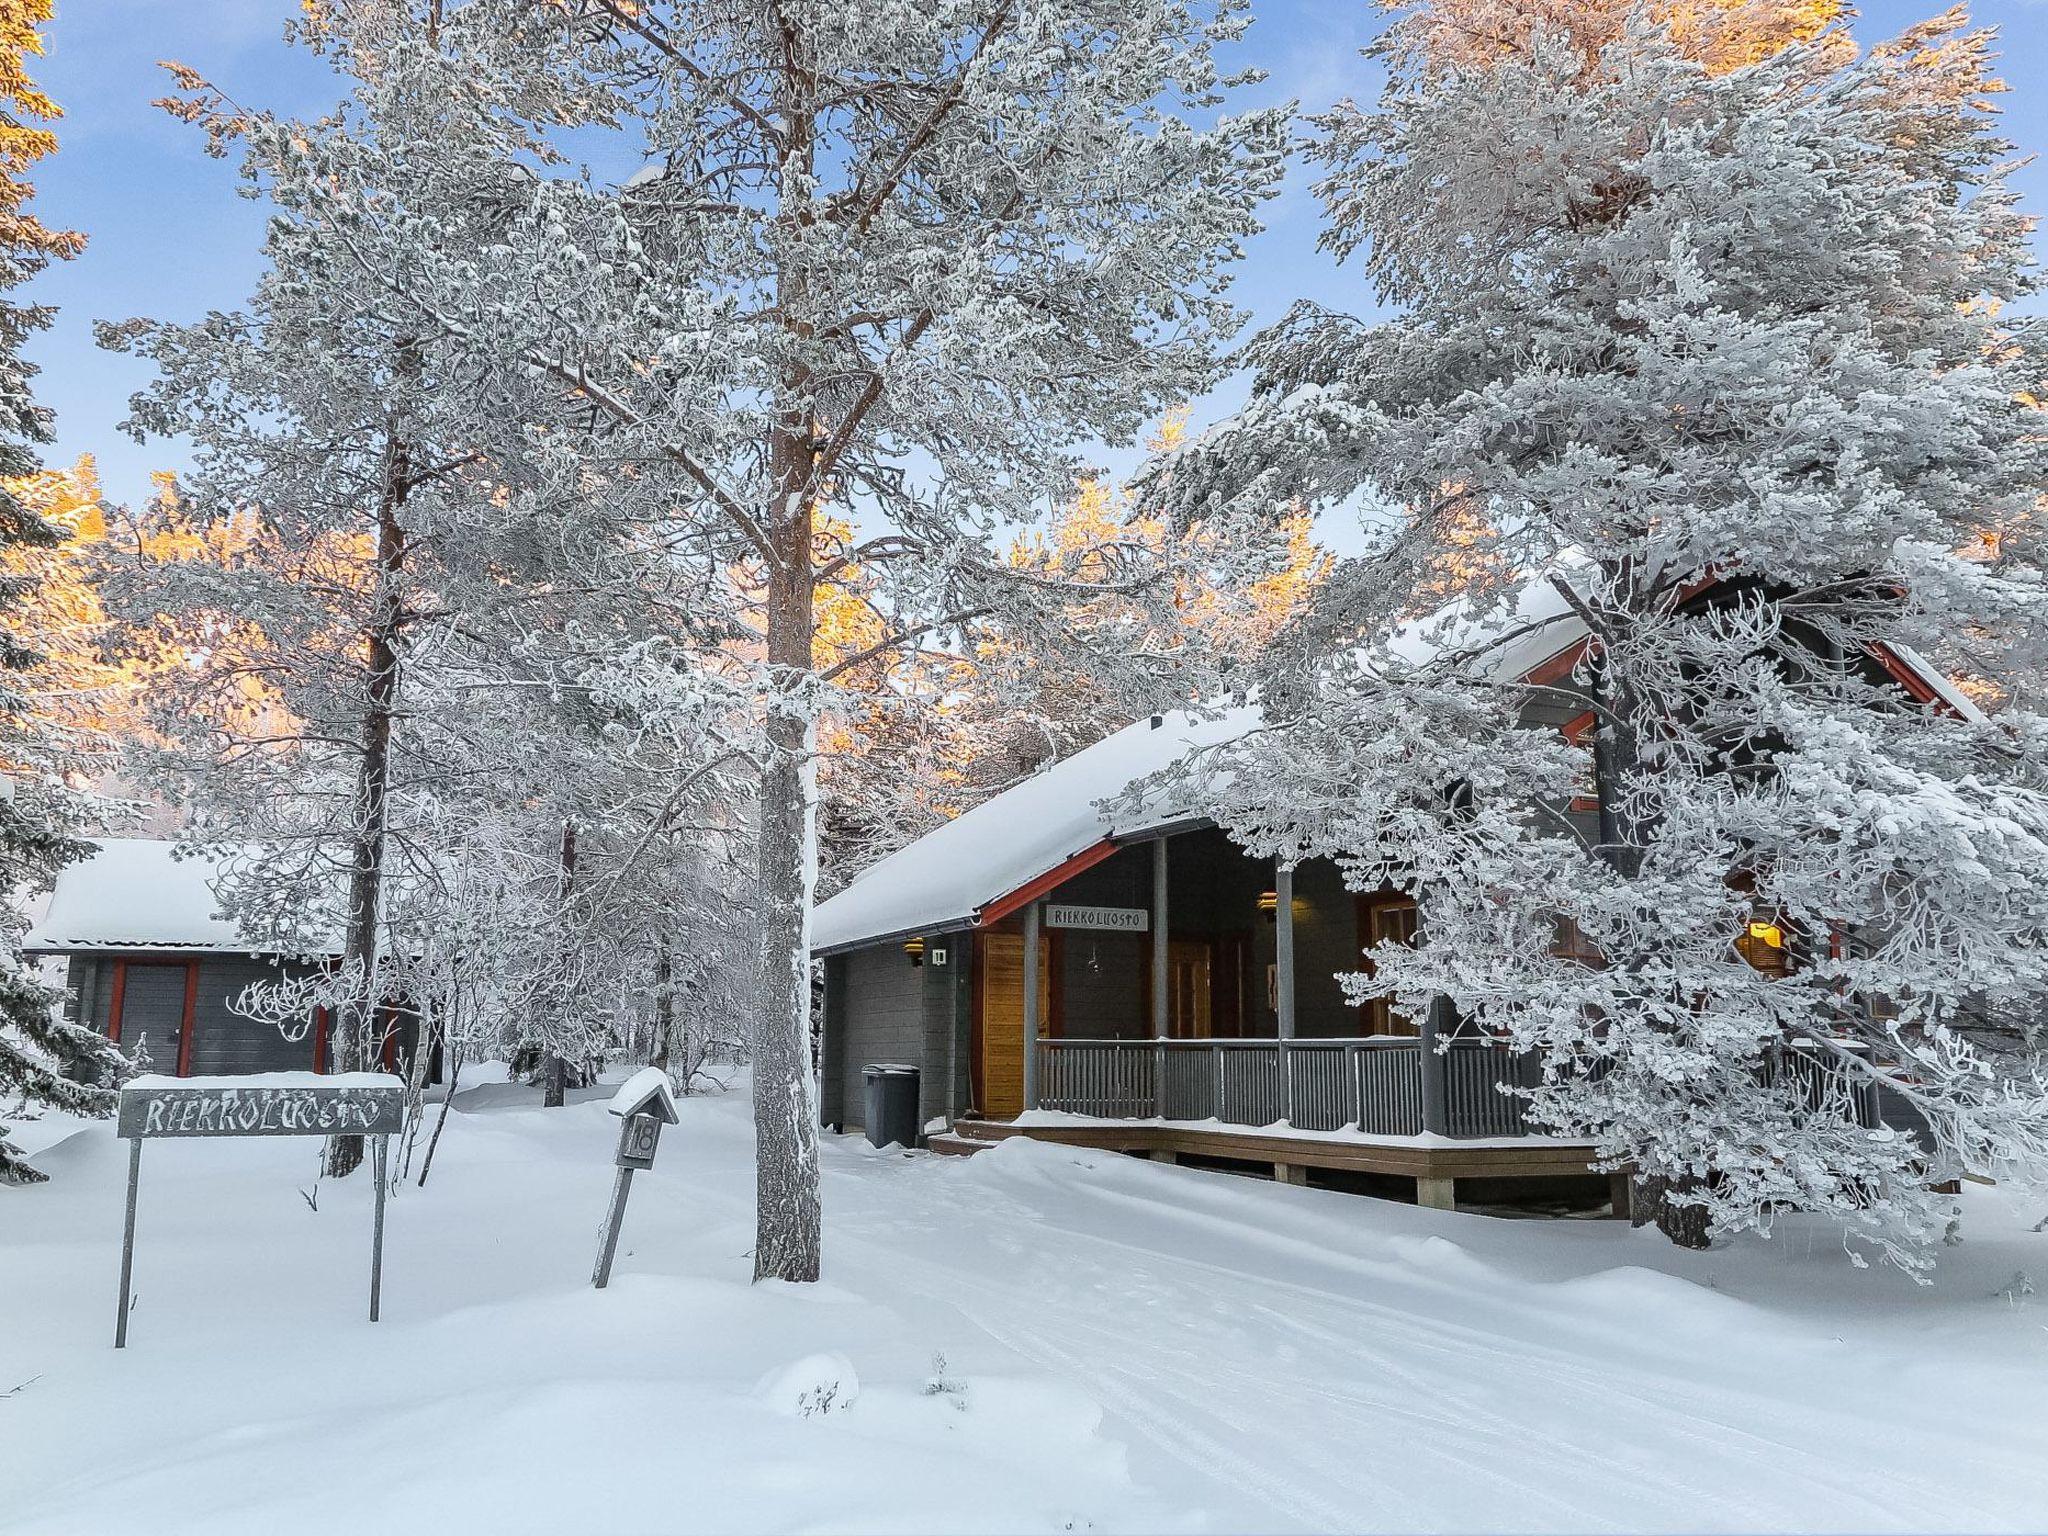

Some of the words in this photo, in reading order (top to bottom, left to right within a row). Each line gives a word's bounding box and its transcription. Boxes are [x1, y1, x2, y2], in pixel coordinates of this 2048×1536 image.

[1055, 910, 1140, 926] RIEKKOLUOSTO
[144, 1093, 380, 1133] RIEKKOLUOSTO
[635, 1126, 653, 1150] 18
